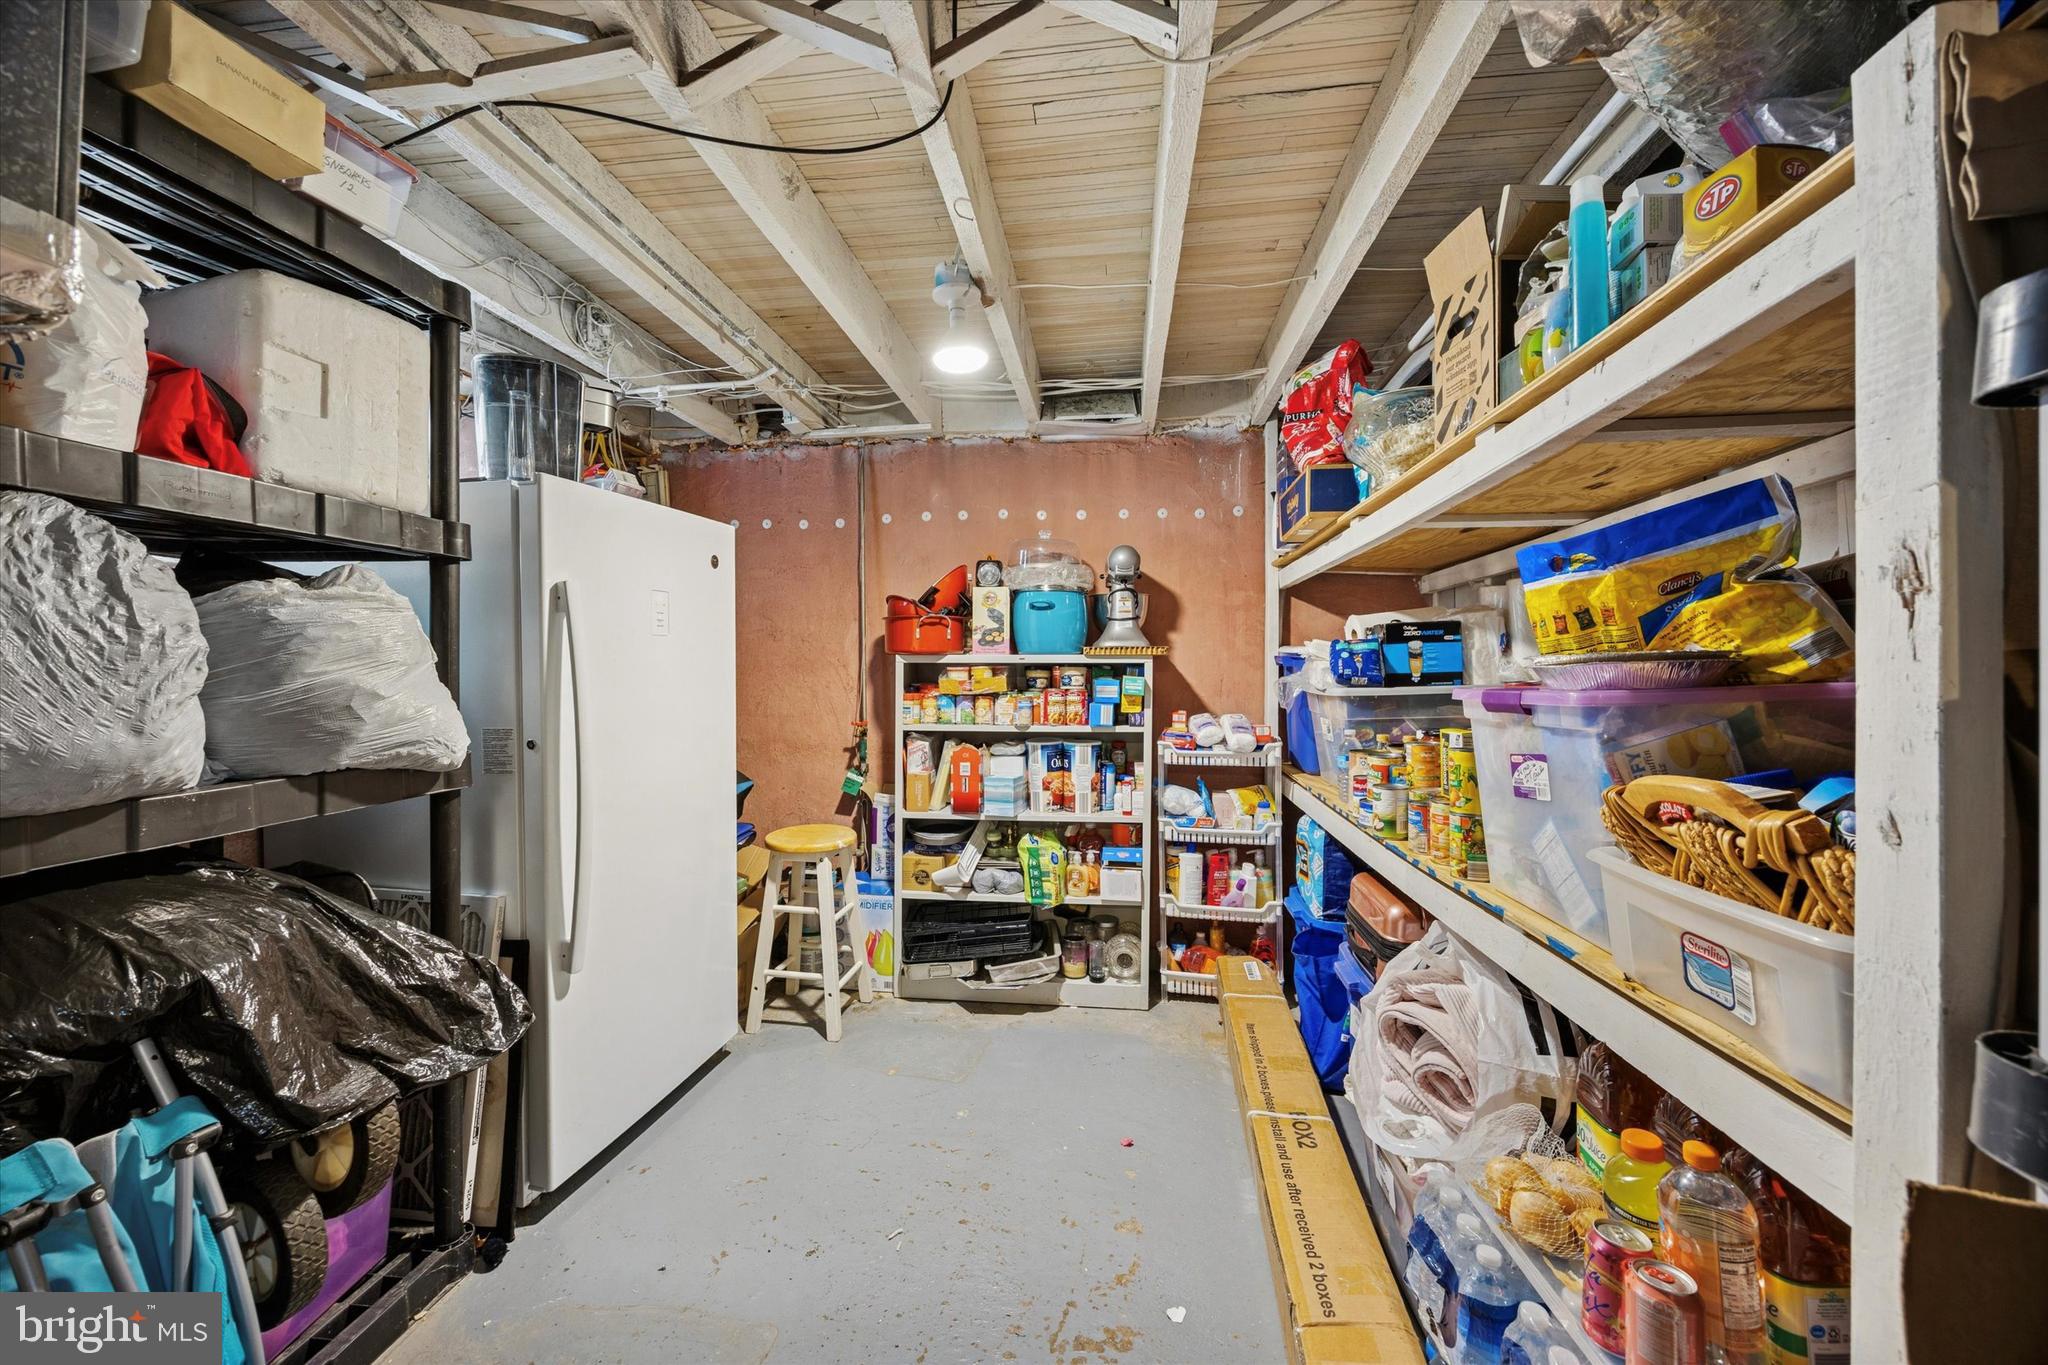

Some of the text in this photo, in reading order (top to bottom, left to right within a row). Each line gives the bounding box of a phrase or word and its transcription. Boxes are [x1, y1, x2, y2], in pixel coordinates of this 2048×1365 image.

[1783, 161, 1807, 180] STP
[339, 180, 357, 195] 12
[1701, 181, 1735, 214] STP
[1658, 572, 1702, 595] Clancy's
[1403, 629, 1445, 637] ZEROWATER
[1688, 936, 1725, 962] Sterilite
[1249, 1035, 1264, 1060] shipped
[1277, 1143, 1292, 1161] and
[1281, 1162, 1295, 1181] use
[1287, 1181, 1302, 1207] after
[1294, 1207, 1322, 1259] received
[1309, 1262, 1325, 1271] 2
[1312, 1273, 1336, 1319] boxes
